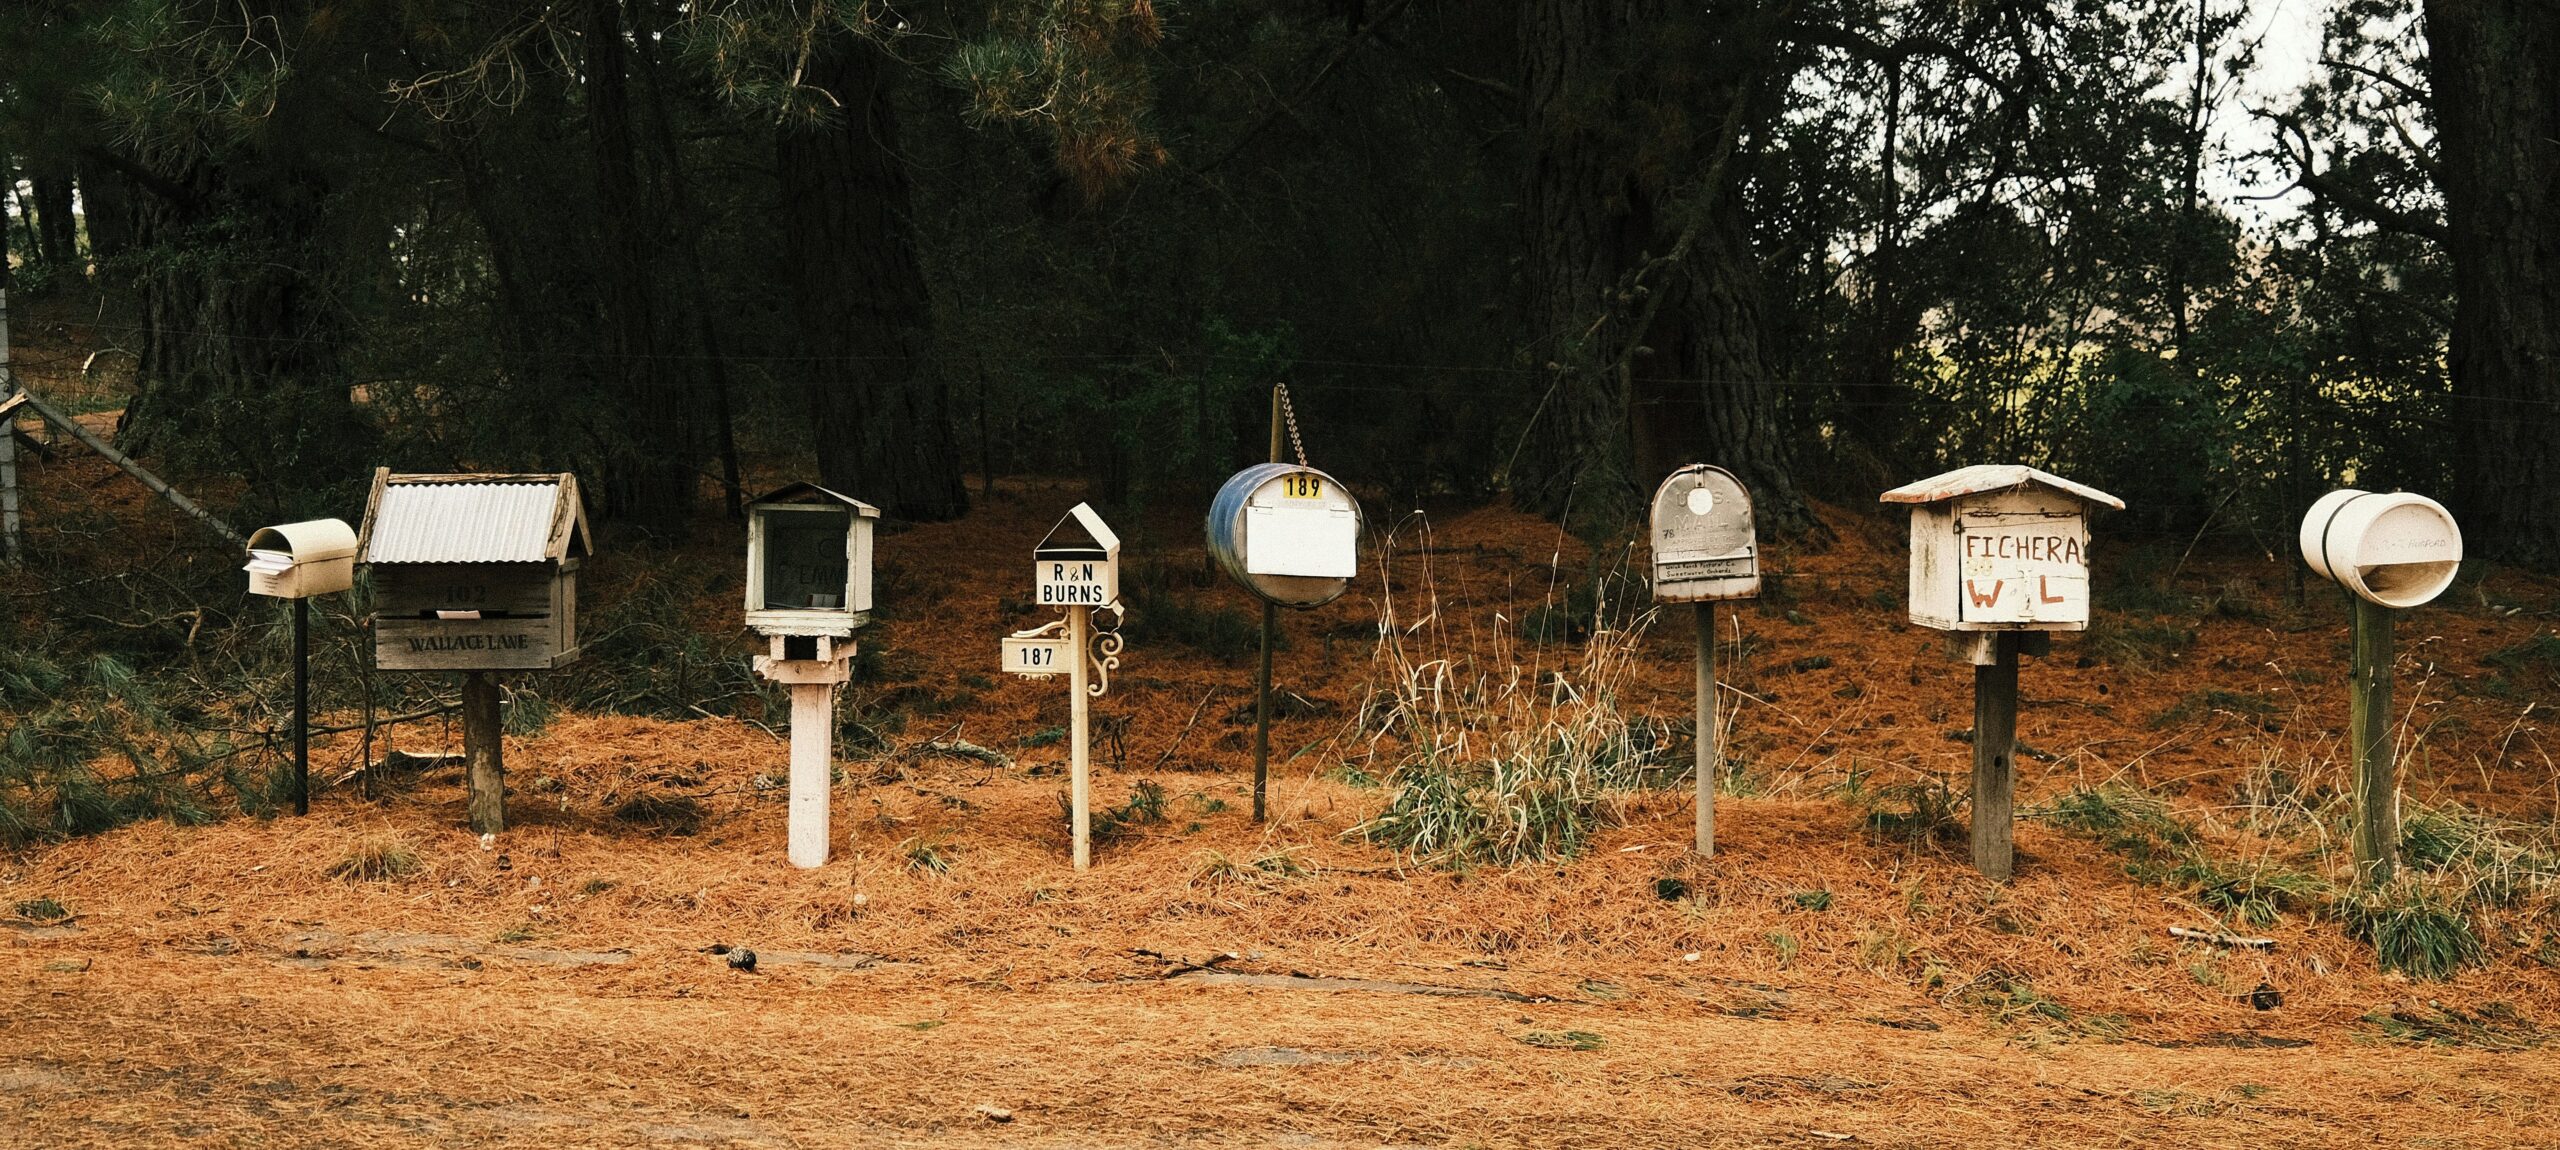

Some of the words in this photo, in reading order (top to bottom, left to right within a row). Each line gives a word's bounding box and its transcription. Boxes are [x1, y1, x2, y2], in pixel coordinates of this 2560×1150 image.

[1287, 478, 1320, 496] 189
[1674, 512, 1729, 531] MAIL
[1966, 535, 2083, 564] FICHERA
[1054, 563, 1064, 581] R
[1070, 566, 1080, 582] &
[1082, 563, 1093, 581] N
[1666, 570, 1704, 578] Sweetwater
[446, 584, 486, 603] 102
[1043, 585, 1102, 602] BURNS
[1966, 579, 2004, 608] W
[2039, 574, 2064, 605] L
[408, 635, 484, 653] WALLACE
[487, 633, 529, 650] LANE
[1021, 648, 1053, 665] 187
